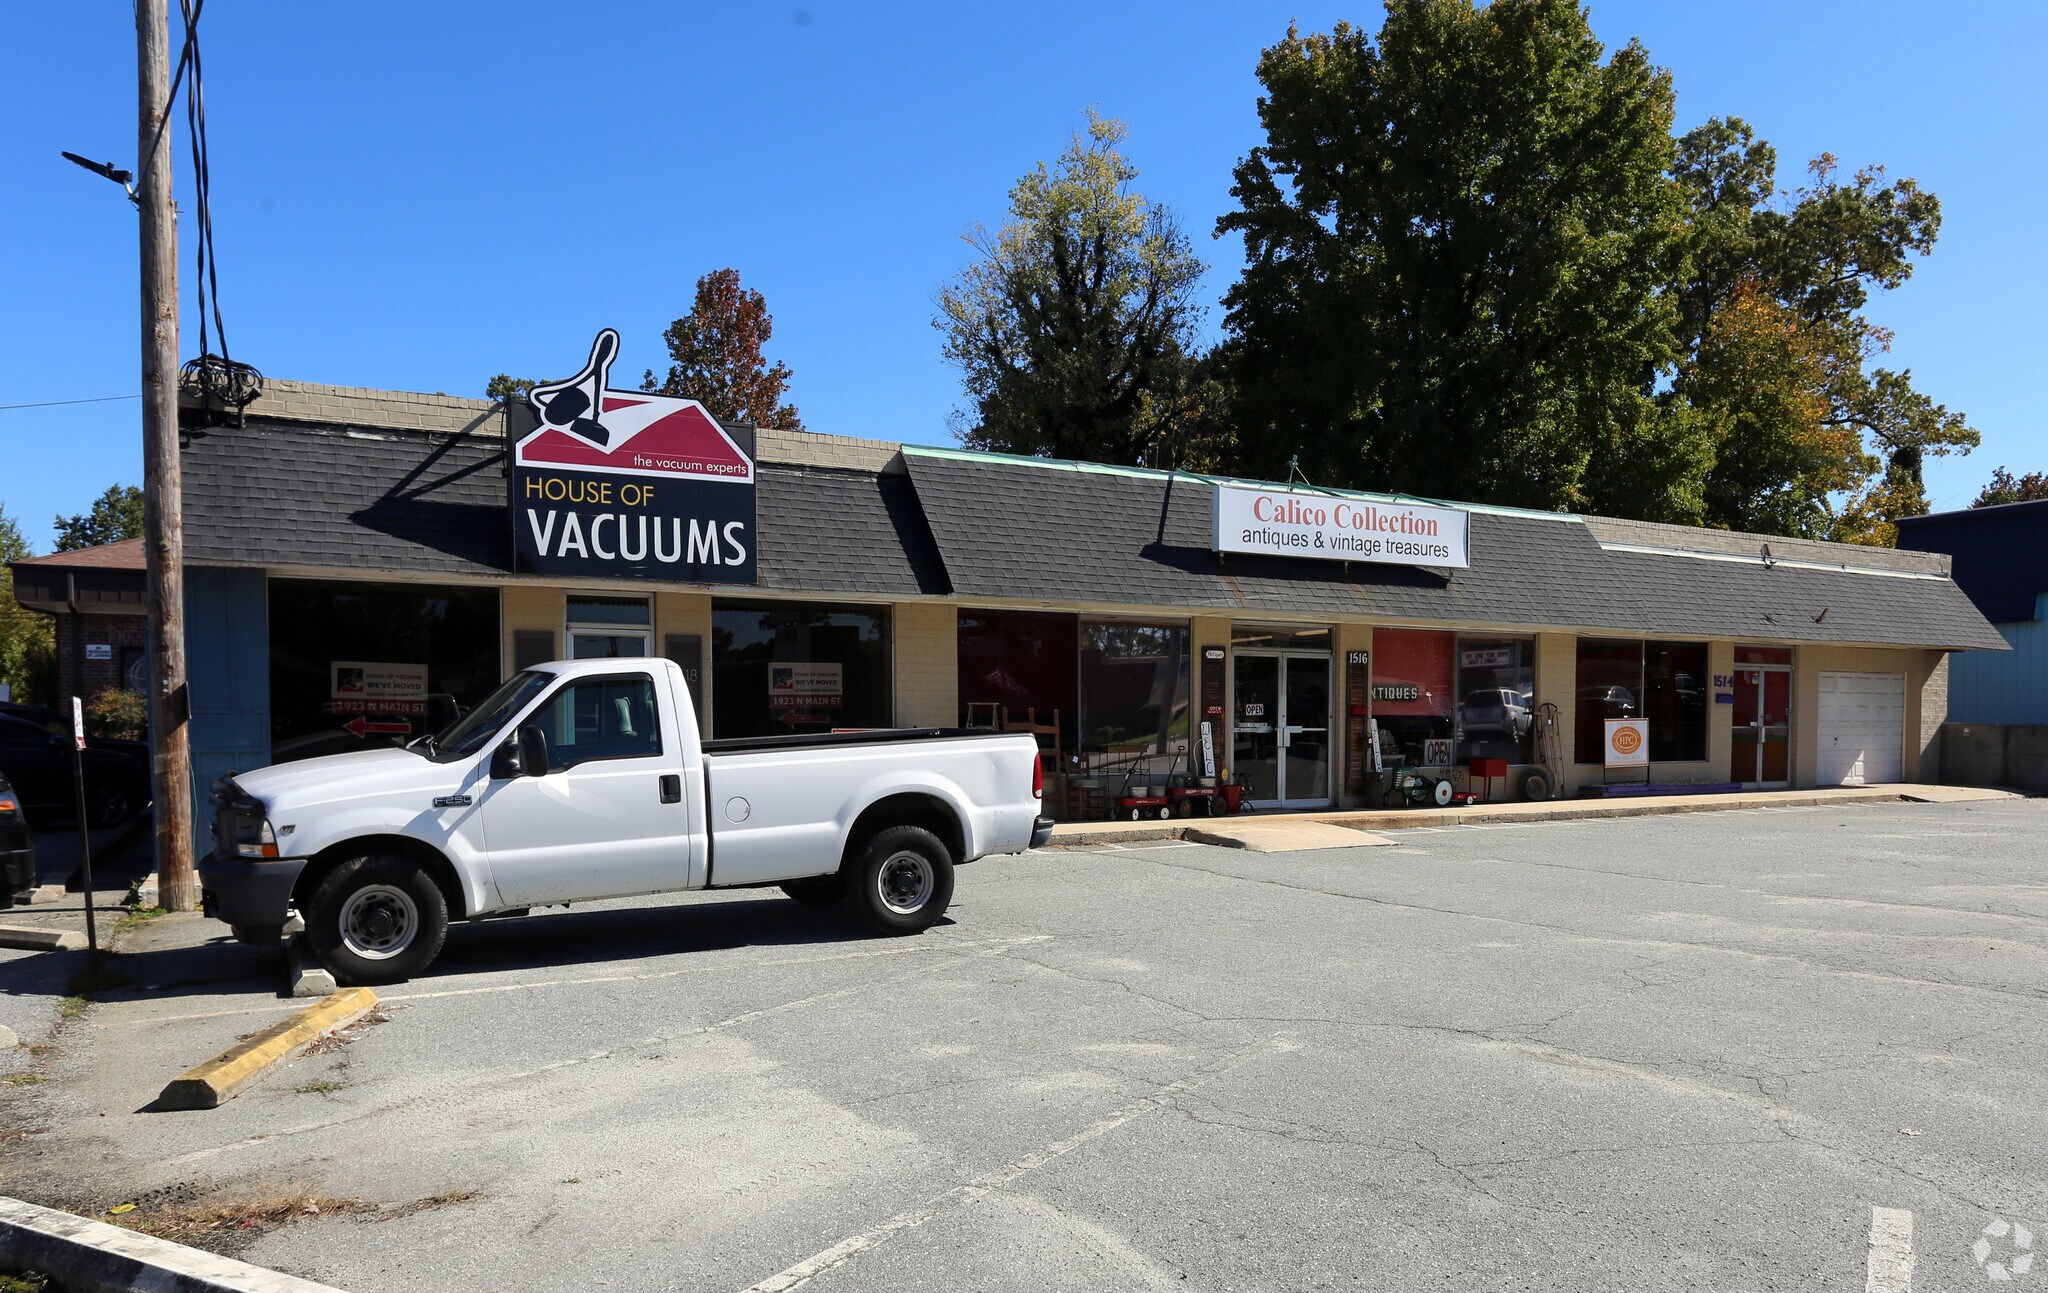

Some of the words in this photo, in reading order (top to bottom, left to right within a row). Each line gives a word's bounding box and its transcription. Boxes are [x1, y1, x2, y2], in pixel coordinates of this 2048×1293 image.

[634, 455, 652, 467] the
[656, 458, 703, 471] vacuum
[706, 461, 747, 476] experts
[526, 476, 612, 504] HOUSE
[620, 484, 654, 507] OF
[1253, 496, 1327, 527] Calico
[1334, 503, 1439, 537] Collection
[527, 508, 747, 567] VACUUMS
[1242, 528, 1309, 549] antiques
[1314, 530, 1325, 549] &
[1329, 533, 1382, 556] vintage
[1385, 538, 1449, 558] treasures
[1349, 652, 1368, 664] 1516
[685, 669, 698, 682] 18
[1713, 674, 1734, 687] 1514
[367, 681, 391, 690] WE'VE
[393, 682, 421, 690] MOVED
[1372, 687, 1418, 700] NTIQUES
[338, 701, 364, 711] 1923
[368, 702, 377, 711] N
[380, 703, 409, 712] MAIN
[412, 703, 426, 713] ST
[773, 697, 794, 705] 1923
[796, 697, 803, 705] N
[805, 697, 827, 705] MAIN
[830, 697, 841, 705] ST
[1246, 705, 1264, 715] OPEN
[1619, 735, 1635, 745] HPC
[1427, 741, 1451, 764] OPEN
